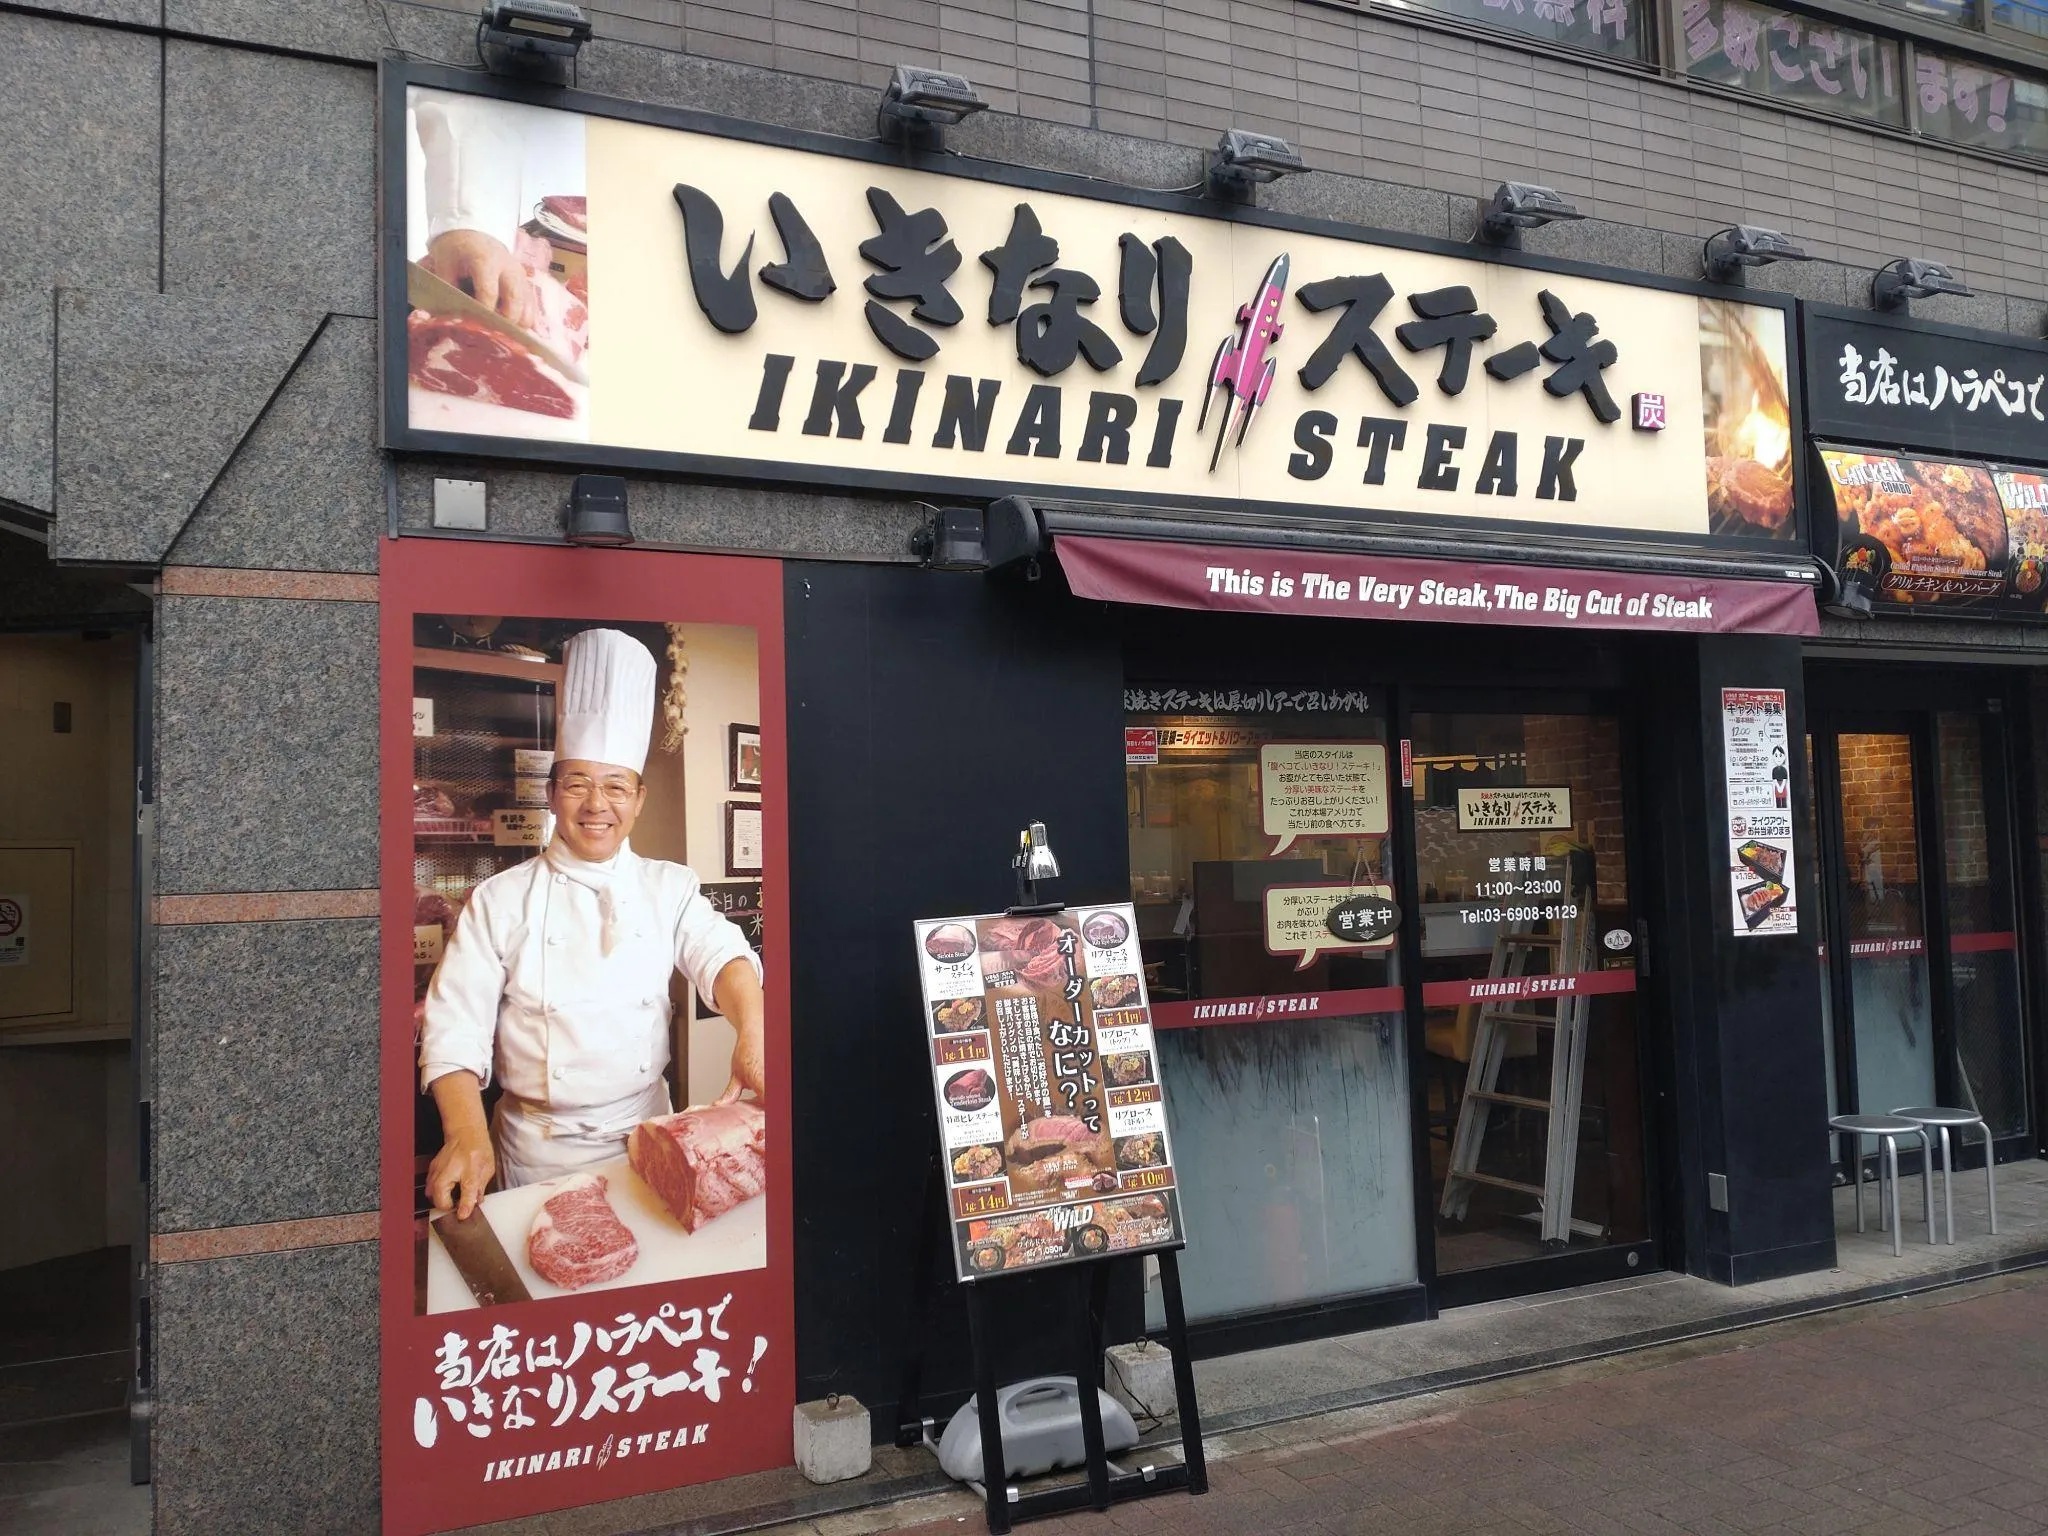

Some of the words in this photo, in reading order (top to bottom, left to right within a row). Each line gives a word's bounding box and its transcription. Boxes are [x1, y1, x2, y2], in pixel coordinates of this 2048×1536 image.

[673, 182, 1193, 389] いきなり
[1295, 272, 1621, 424] ステーキ
[1838, 342, 2045, 421] 当店はハラペコで
[1636, 392, 1666, 430] 炭
[748, 353, 1184, 469] IKINARI
[1287, 409, 1585, 502] STEAK
[1829, 458, 1906, 486] CHICKEN
[1881, 481, 1912, 495] COMBO
[1206, 566, 1265, 597] This
[1269, 570, 1295, 598] is
[1301, 572, 1351, 600] The
[1358, 576, 1414, 610] Very
[1542, 587, 1582, 619] Big
[1585, 589, 1623, 615] Cut
[1626, 593, 1650, 616] of
[1652, 593, 1713, 619] Steak
[1294, 750, 1354, 760] 当店のスタイルは
[1467, 800, 1511, 817] いきなり
[1521, 800, 1557, 815] ステーキ
[1473, 817, 1511, 826] IKINARI
[1521, 816, 1554, 825] STEAK
[1488, 856, 1546, 872] 営業時間
[1338, 906, 1392, 930] 営業中
[1459, 904, 1578, 924] Tel:03-6908-8129
[1850, 942, 1886, 954] IKINARI
[1891, 940, 1922, 951] STEAK
[934, 962, 973, 973] サーロイン
[1470, 980, 1521, 997] IKINARI
[1531, 977, 1576, 993] STEAK
[1193, 1001, 1254, 1019] IKINARI
[1266, 997, 1320, 1014] STEAK
[1059, 936, 1099, 1131] オーダーカットって
[1049, 1020, 1079, 1108] なに？
[1053, 1205, 1094, 1232] WILD
[433, 1292, 734, 1388] 当店はハラペコで
[483, 1444, 592, 1483] IKINARI
[615, 1423, 710, 1459] STEAK
